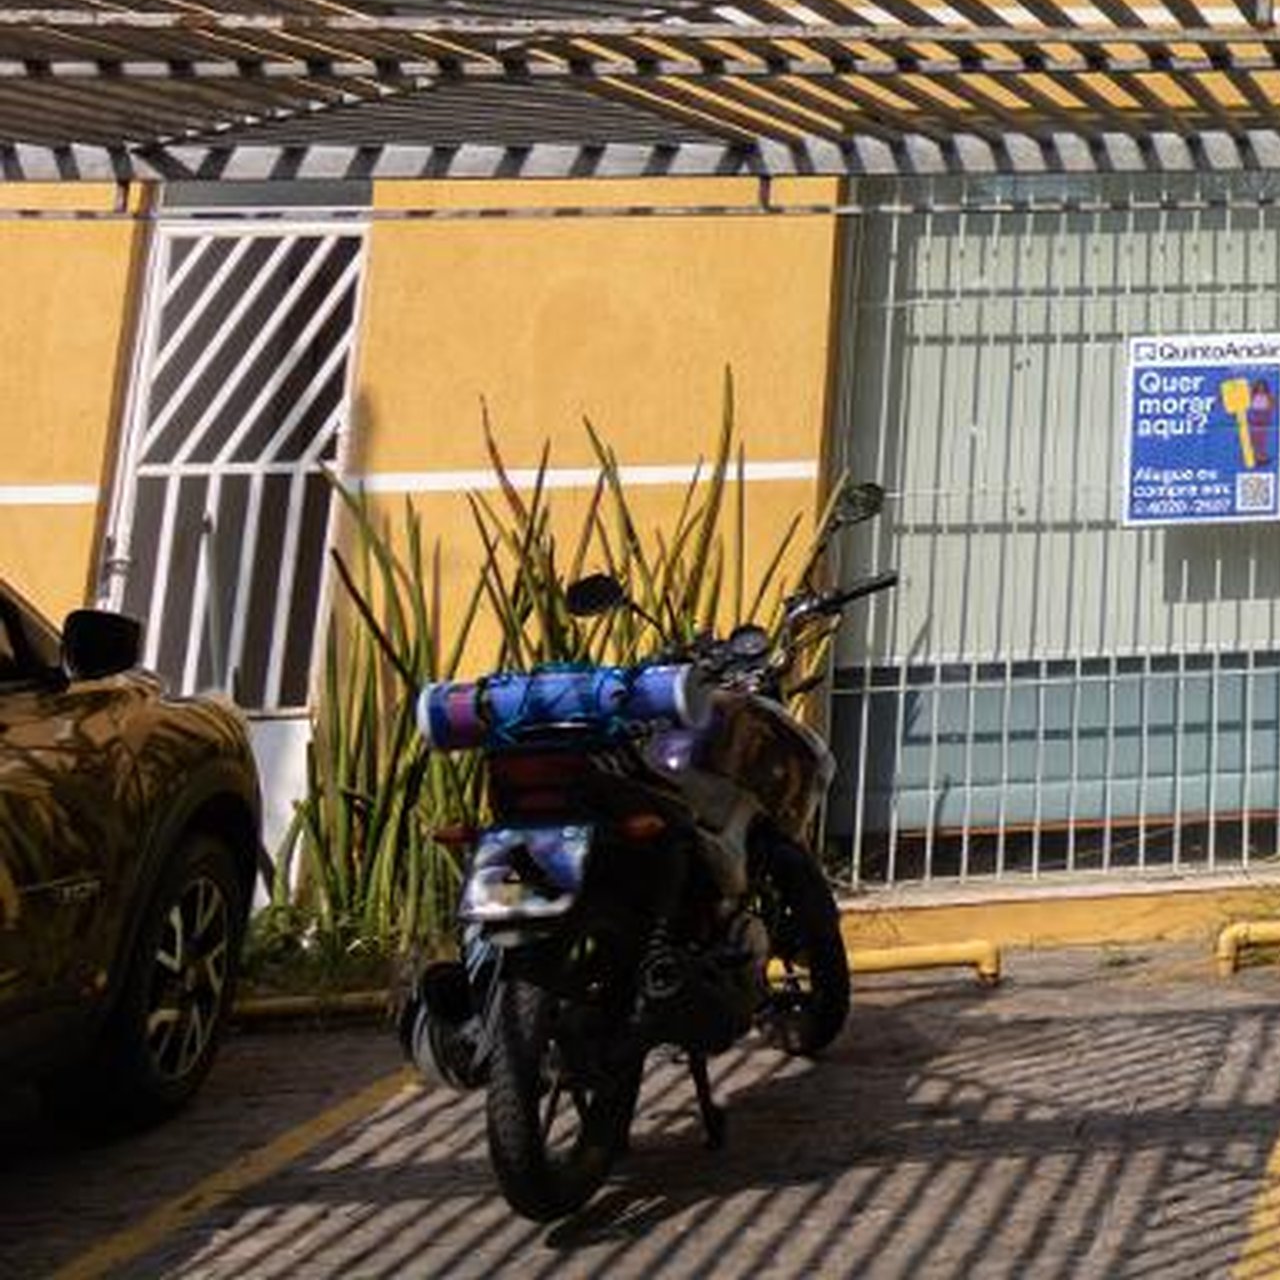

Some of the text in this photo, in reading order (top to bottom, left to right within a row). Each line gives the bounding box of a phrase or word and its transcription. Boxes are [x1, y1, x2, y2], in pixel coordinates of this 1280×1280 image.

[1159, 341, 1280, 361] QuintoAndar
[1139, 371, 1205, 393] Quer
[1138, 395, 1217, 414] morar
[1137, 414, 1209, 439] aqui?
